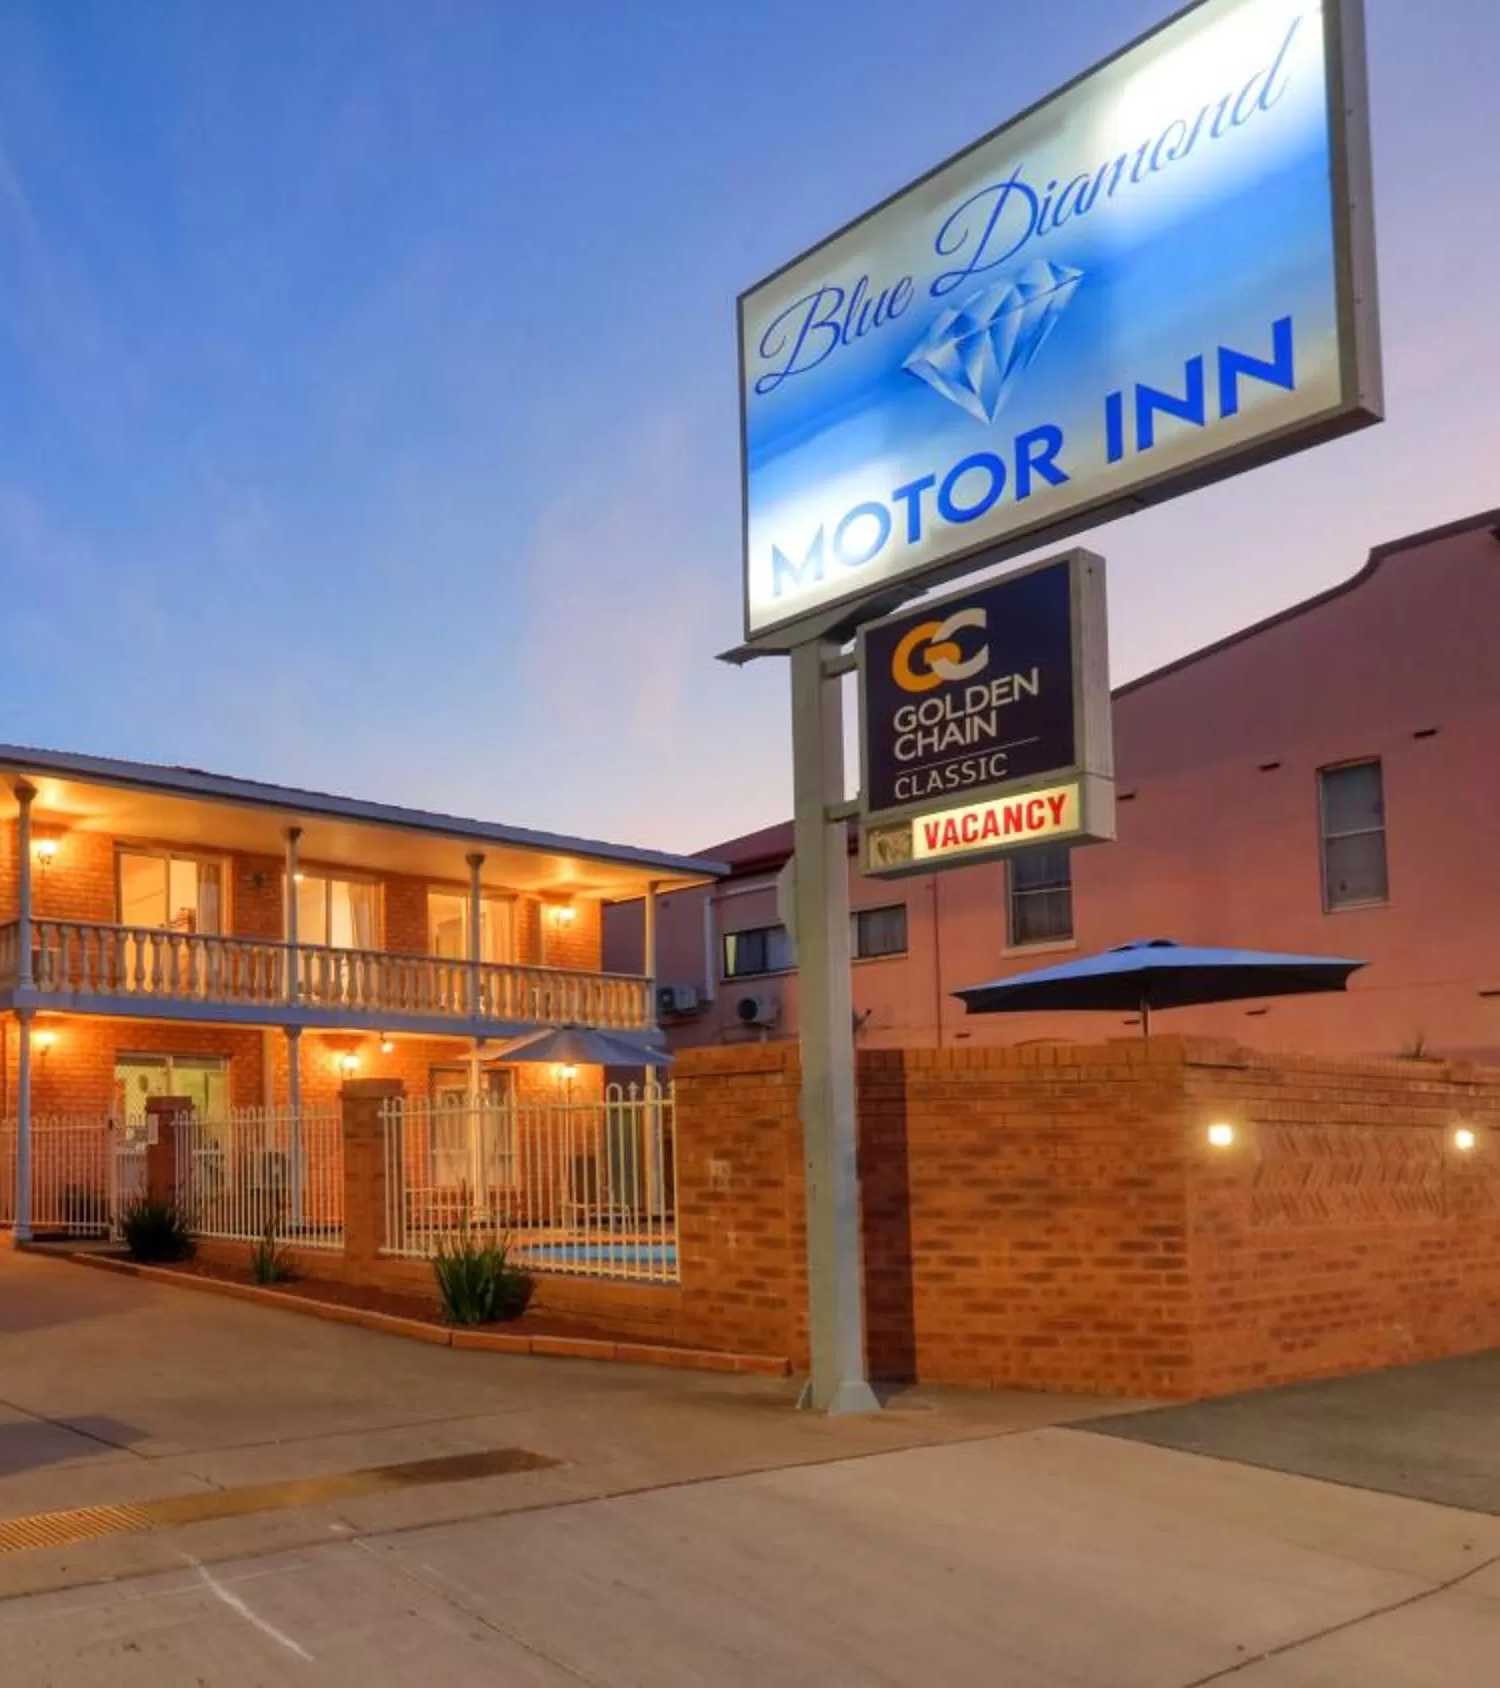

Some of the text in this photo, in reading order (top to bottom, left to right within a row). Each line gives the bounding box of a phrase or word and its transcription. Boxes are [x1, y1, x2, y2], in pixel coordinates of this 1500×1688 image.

[756, 16, 1301, 394] Blue Diamond
[771, 316, 1294, 597] MOTOR INN
[894, 668, 1039, 732] GOLDEN
[894, 710, 997, 760] CHAIN
[895, 754, 1008, 799] CLASSIC
[924, 794, 1066, 850] VACANCY
